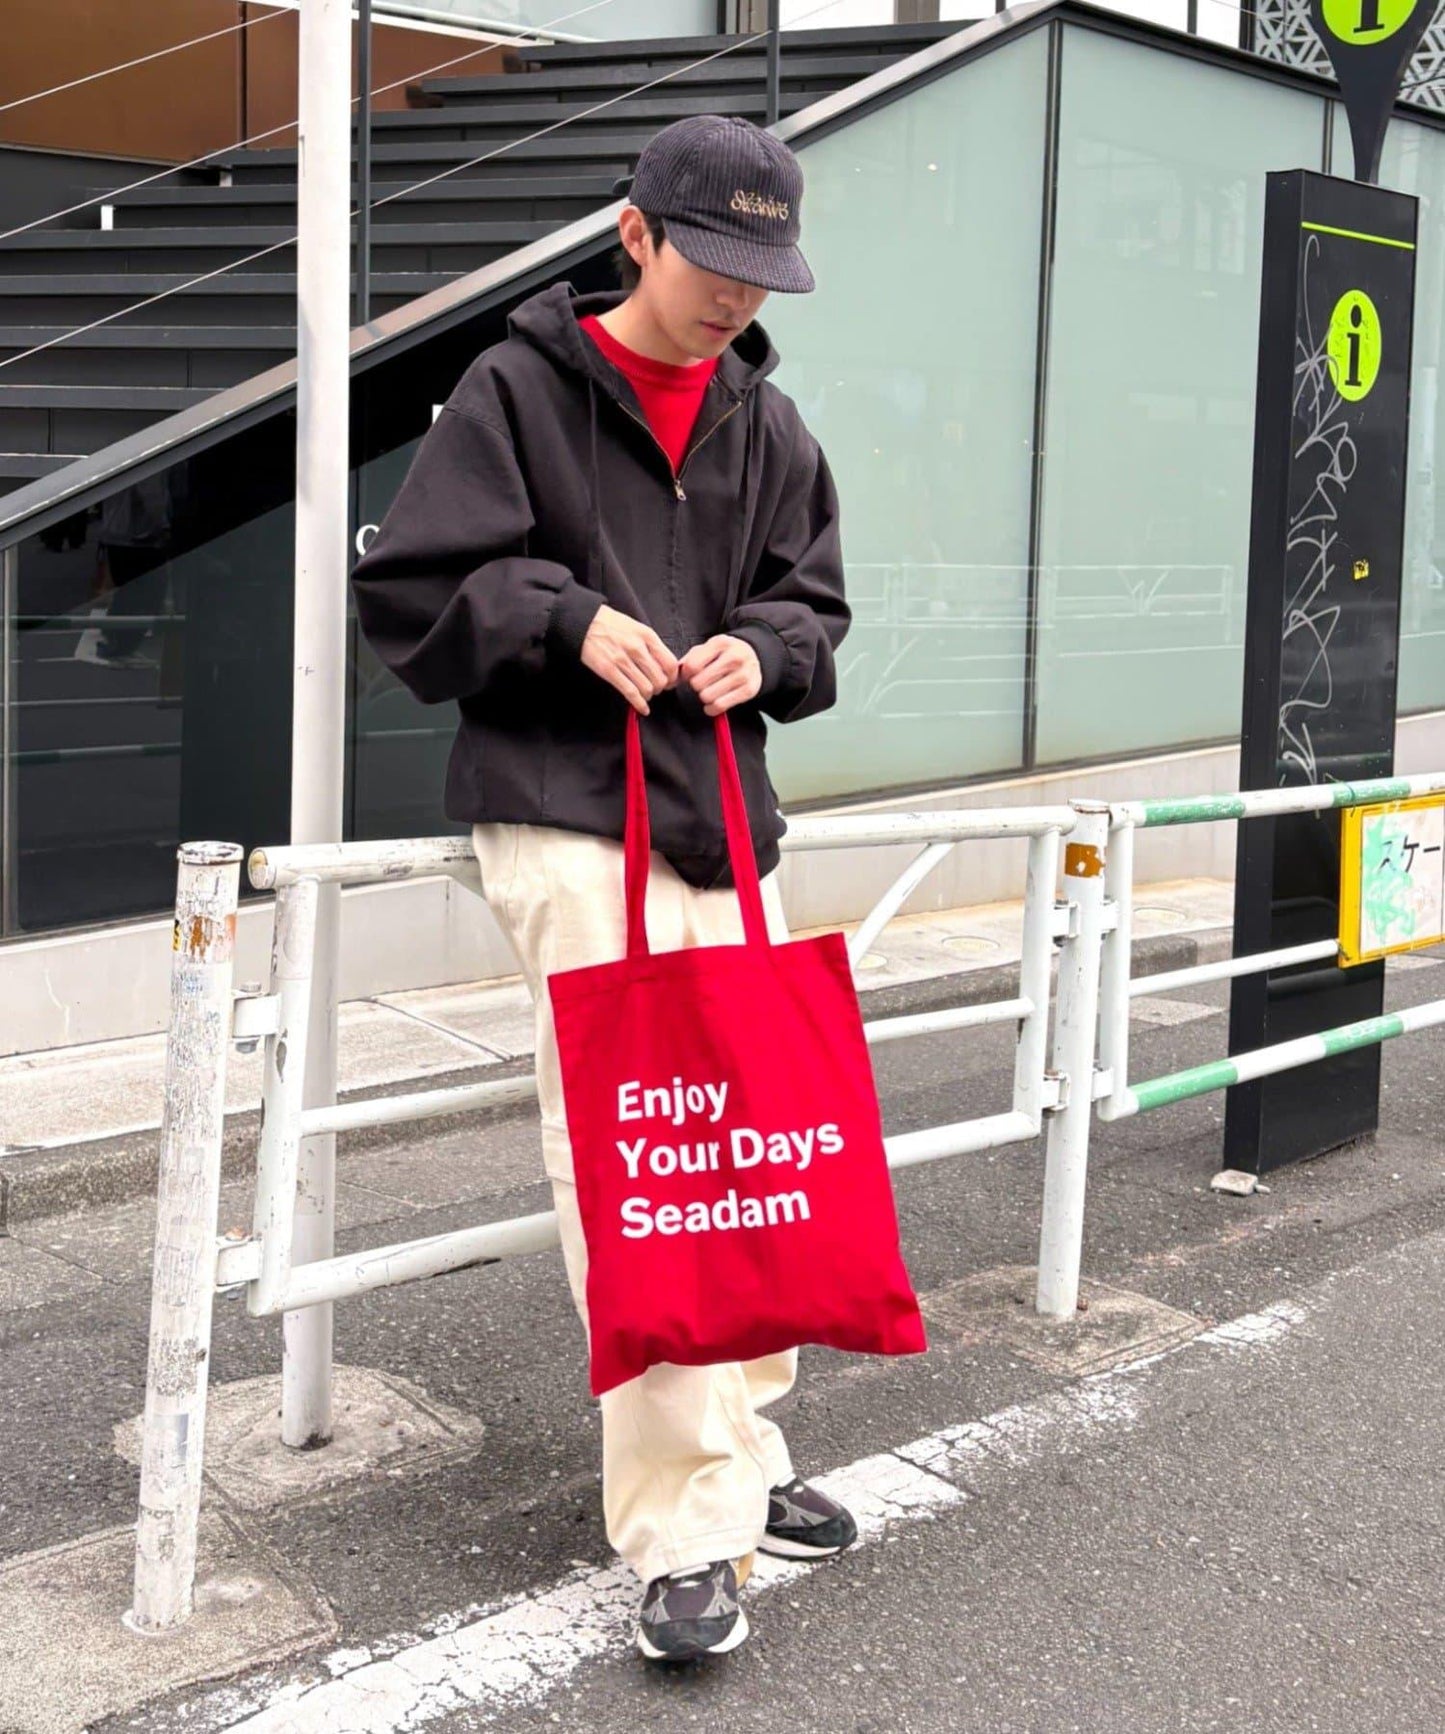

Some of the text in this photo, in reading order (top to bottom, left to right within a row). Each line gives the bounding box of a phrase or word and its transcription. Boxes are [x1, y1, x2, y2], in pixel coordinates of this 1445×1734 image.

[617, 1076, 728, 1126] Enjoy
[615, 1122, 844, 1179] Your Days
[620, 1189, 811, 1239] Seadam
